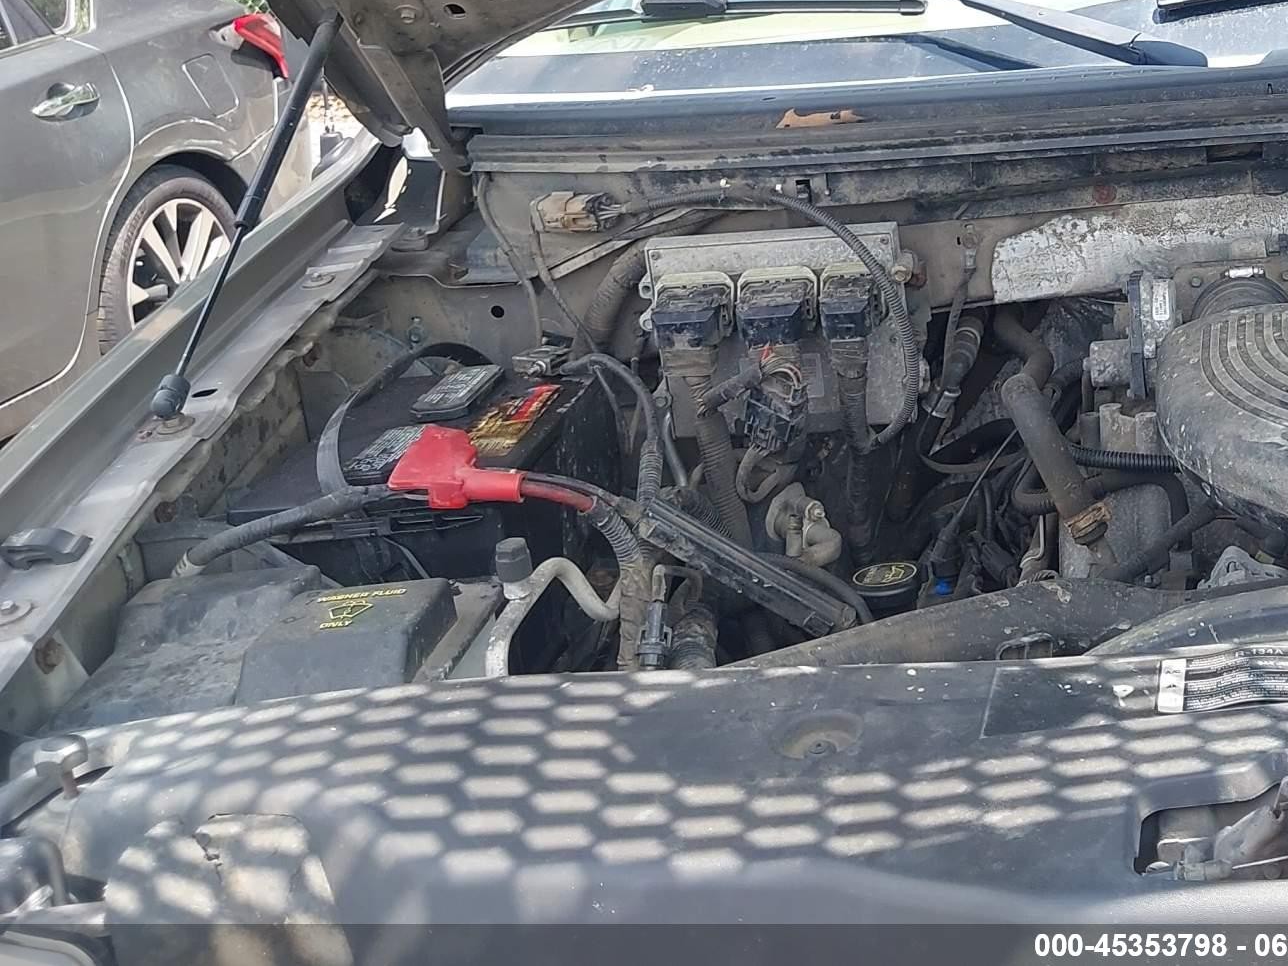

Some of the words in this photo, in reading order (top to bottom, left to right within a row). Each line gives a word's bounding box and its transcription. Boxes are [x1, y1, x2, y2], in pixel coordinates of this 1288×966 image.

[316, 591, 370, 603] WASHER
[371, 588, 407, 597] FLUID
[320, 620, 353, 629] ONLY
[1234, 648, 1285, 658] R-134A
